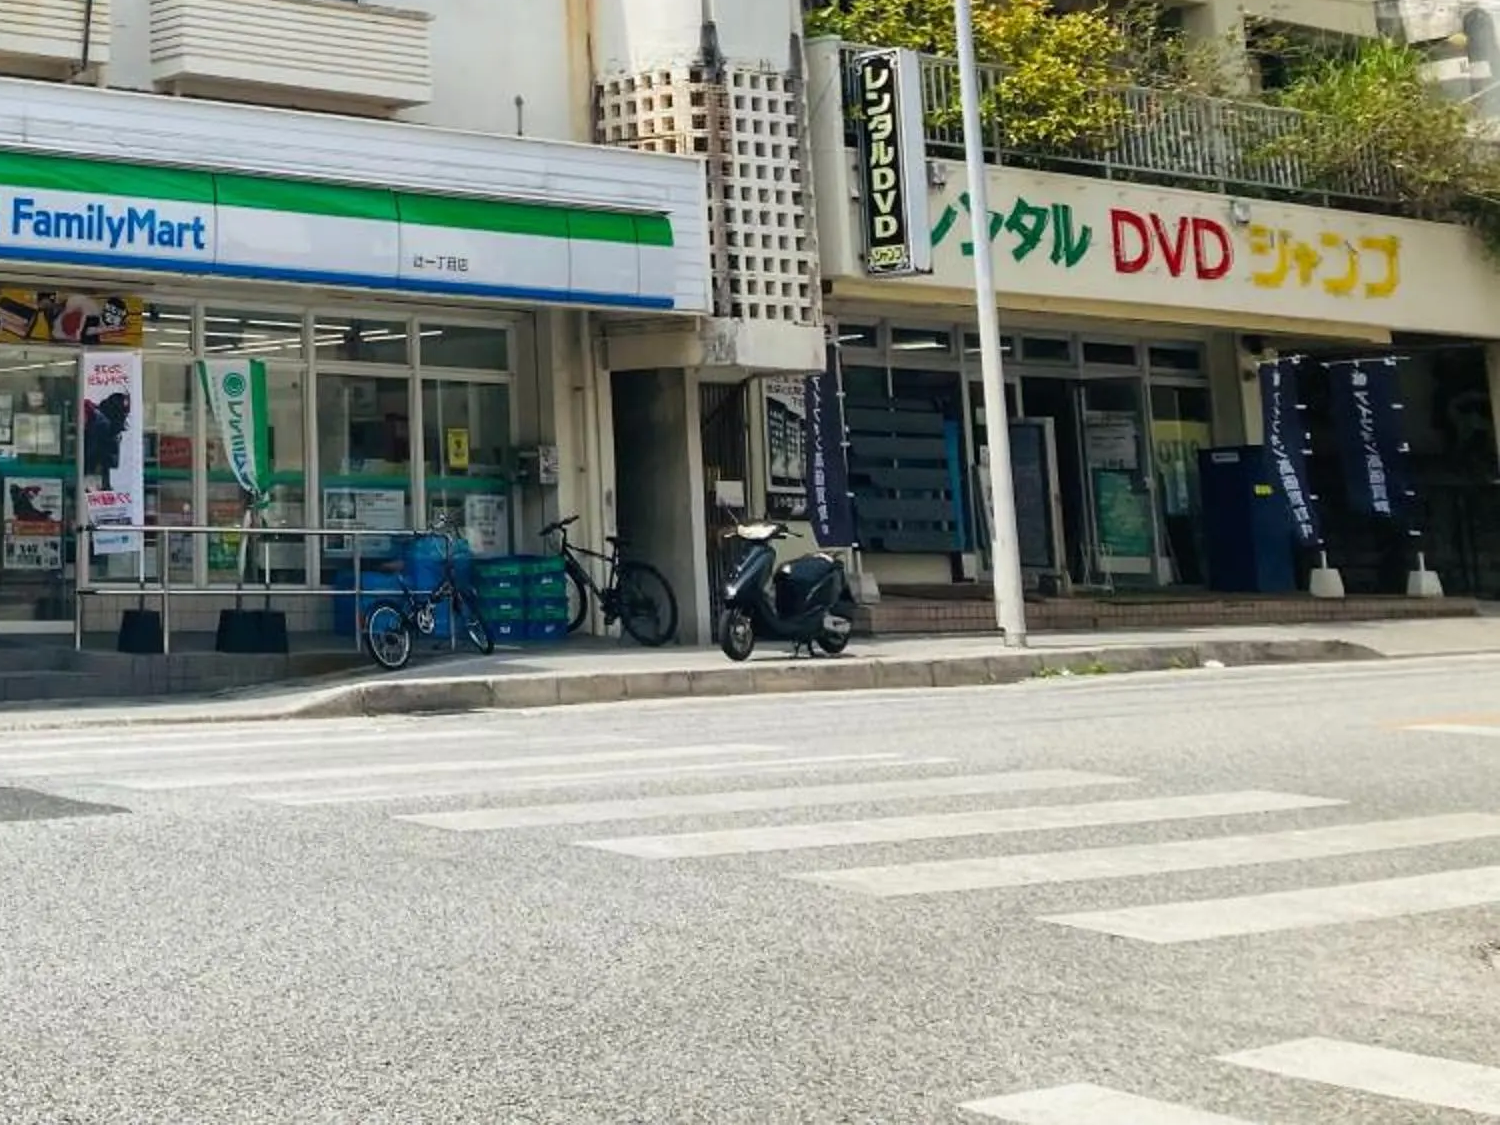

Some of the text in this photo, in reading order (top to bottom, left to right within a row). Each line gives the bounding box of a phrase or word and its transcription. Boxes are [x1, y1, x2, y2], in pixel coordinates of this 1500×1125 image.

[864, 66, 898, 238] レンタルDVD
[11, 197, 206, 250] FamilyMart
[1109, 208, 1233, 280] DVD
